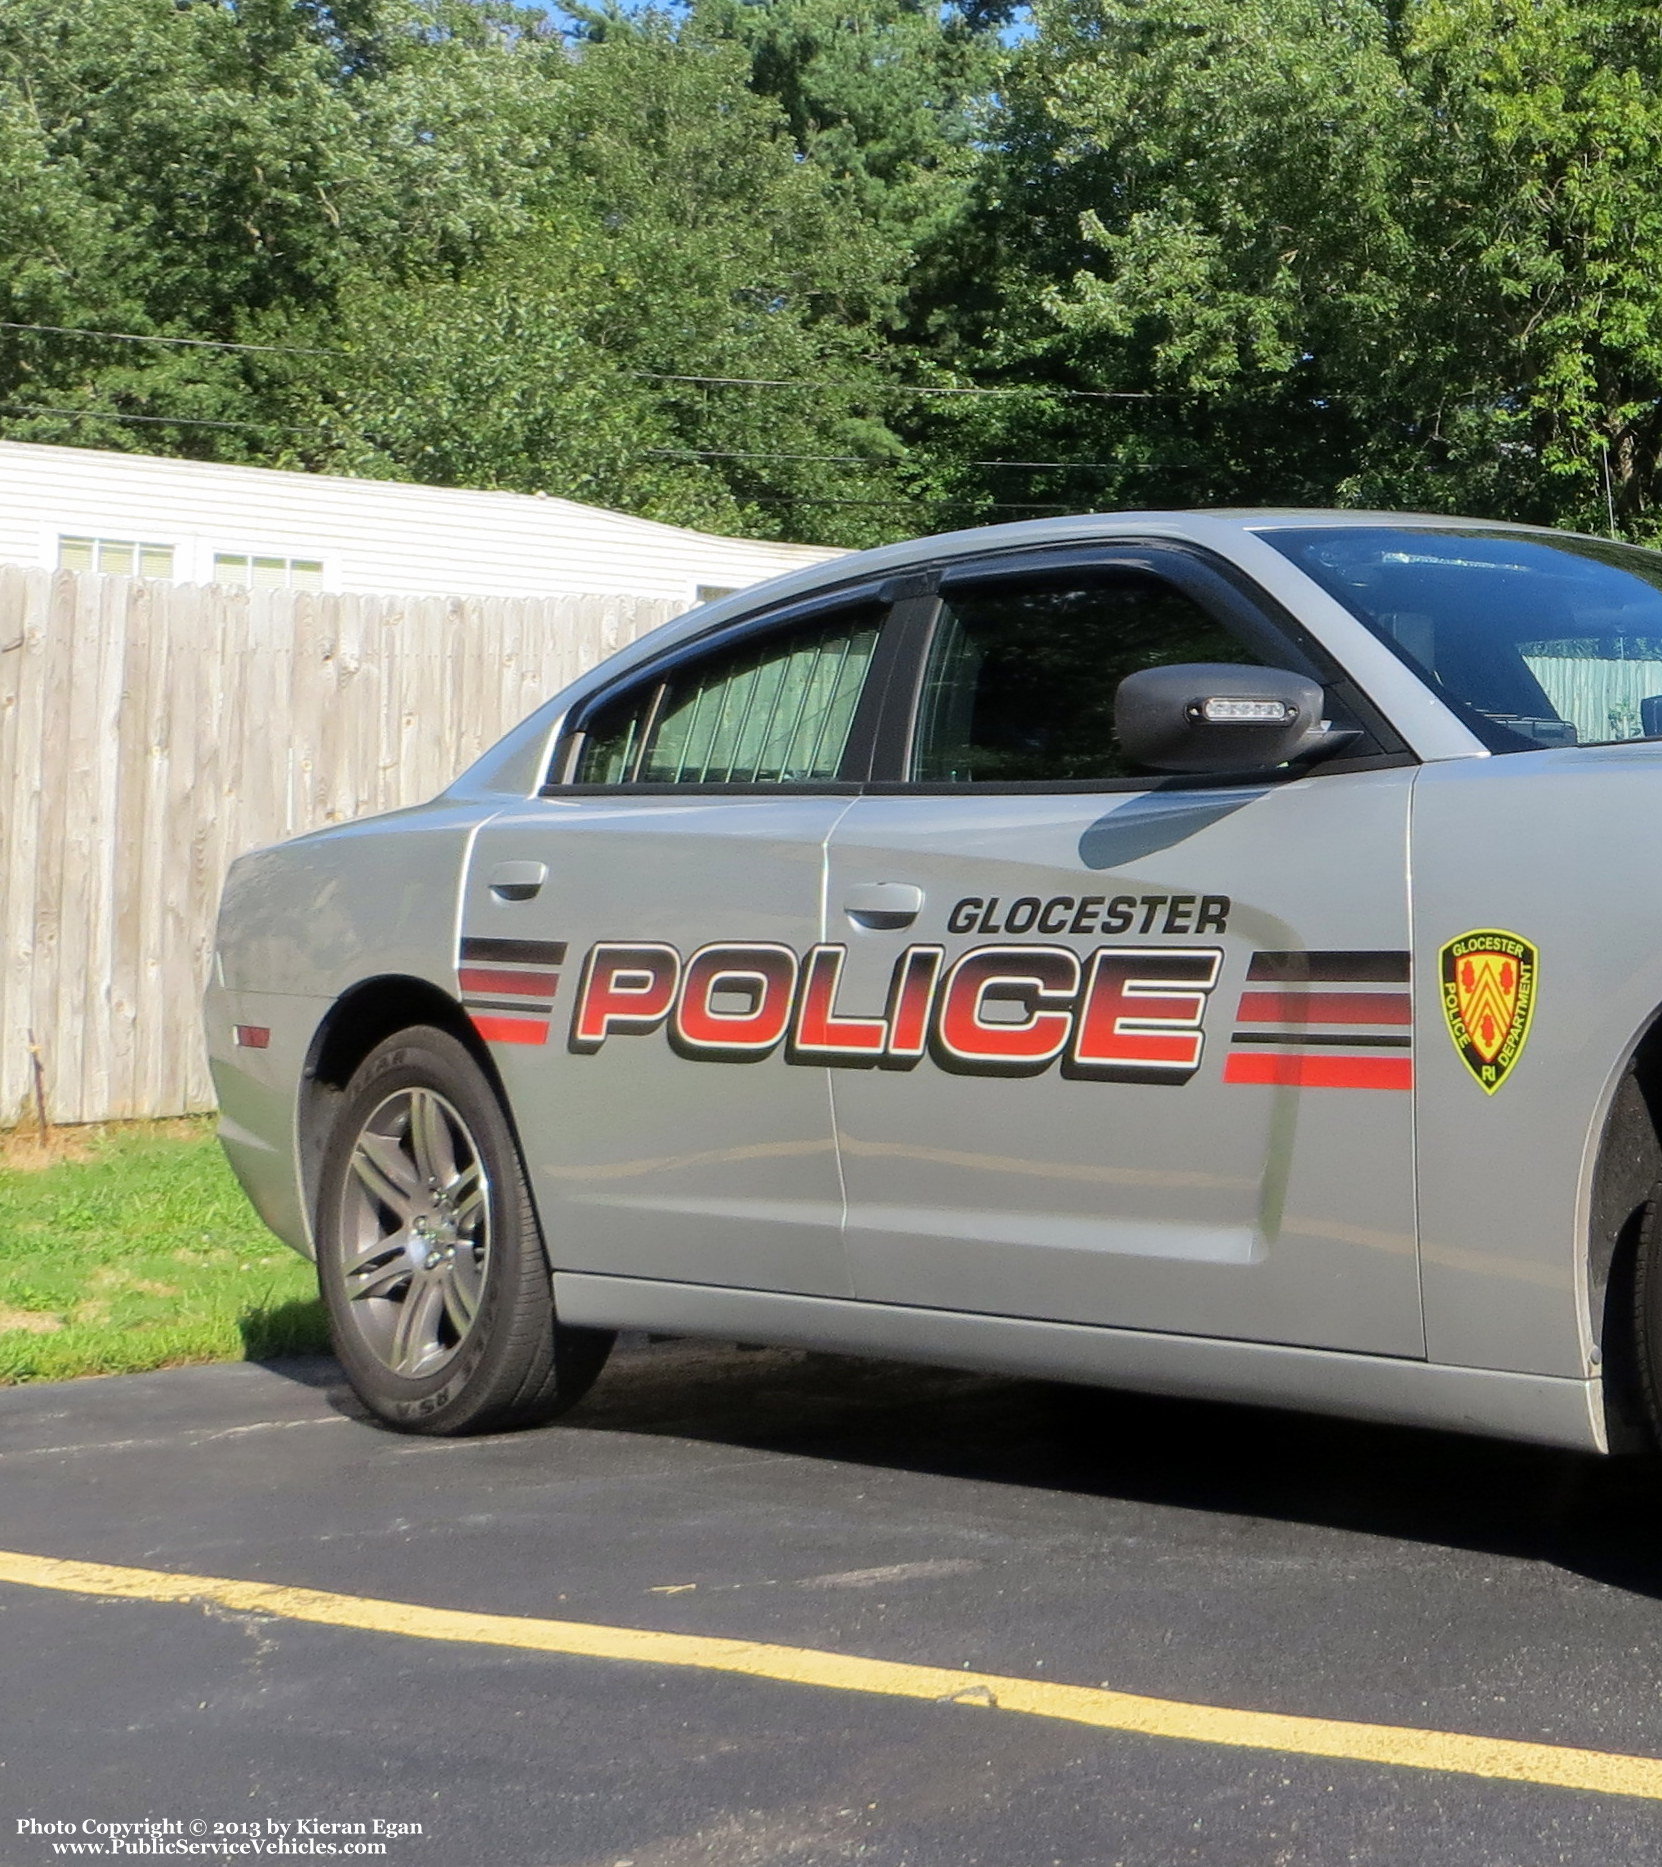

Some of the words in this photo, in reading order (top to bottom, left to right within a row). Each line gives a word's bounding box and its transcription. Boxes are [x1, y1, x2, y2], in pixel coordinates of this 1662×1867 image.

[947, 894, 1231, 937] GLOCESTER
[1452, 936, 1525, 959] GLOCESTER
[567, 938, 1224, 1087] POLICE
[1445, 982, 1472, 1049] POLICE
[1498, 961, 1532, 1068] DEPARTMENT
[1482, 1065, 1496, 1082] RI
